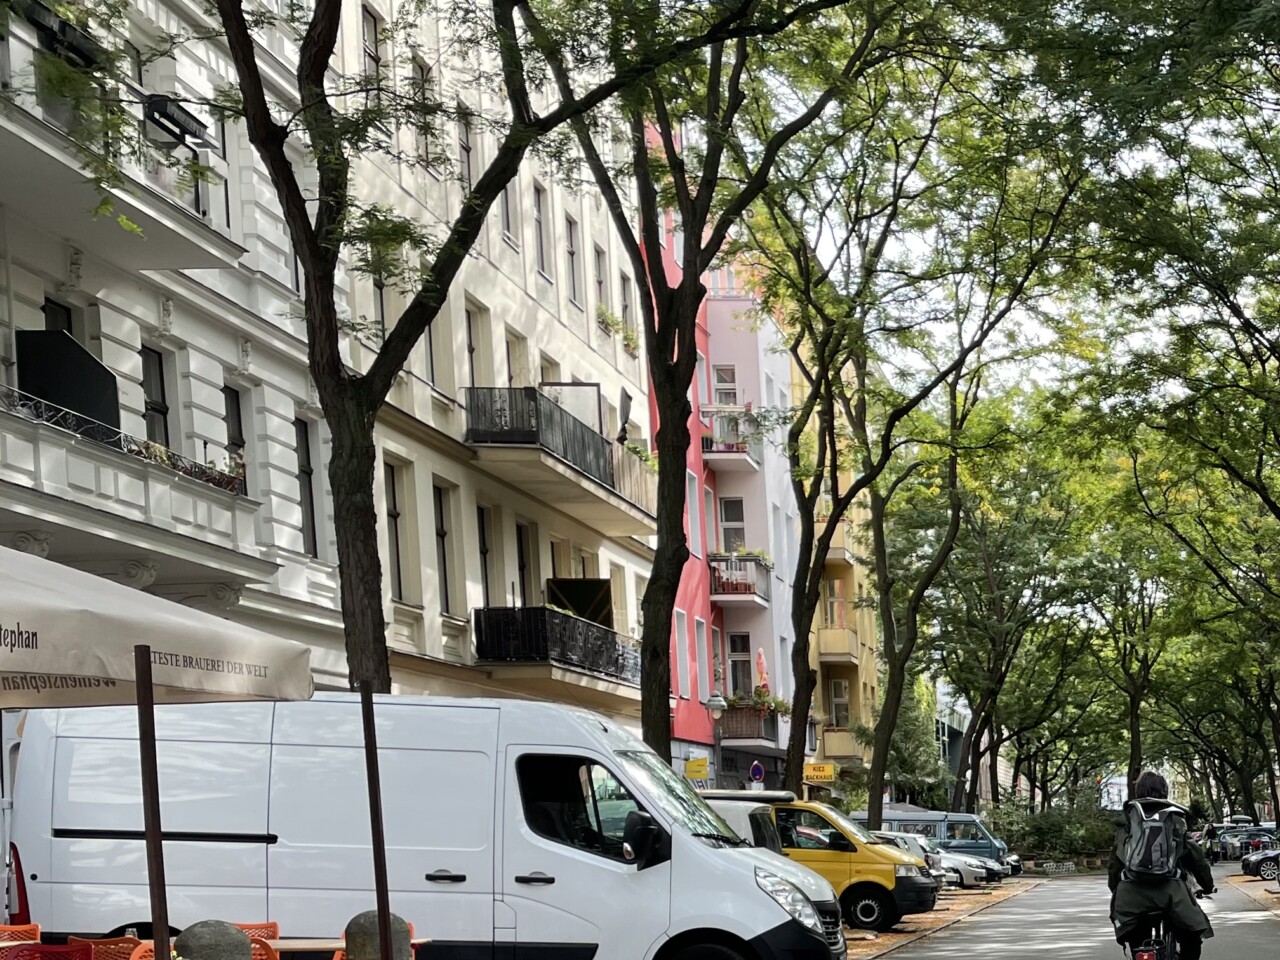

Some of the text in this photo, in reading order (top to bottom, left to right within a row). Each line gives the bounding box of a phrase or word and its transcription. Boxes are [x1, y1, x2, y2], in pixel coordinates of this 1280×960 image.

[150, 650, 268, 678] TESTE BRAUEREI DER WELT
